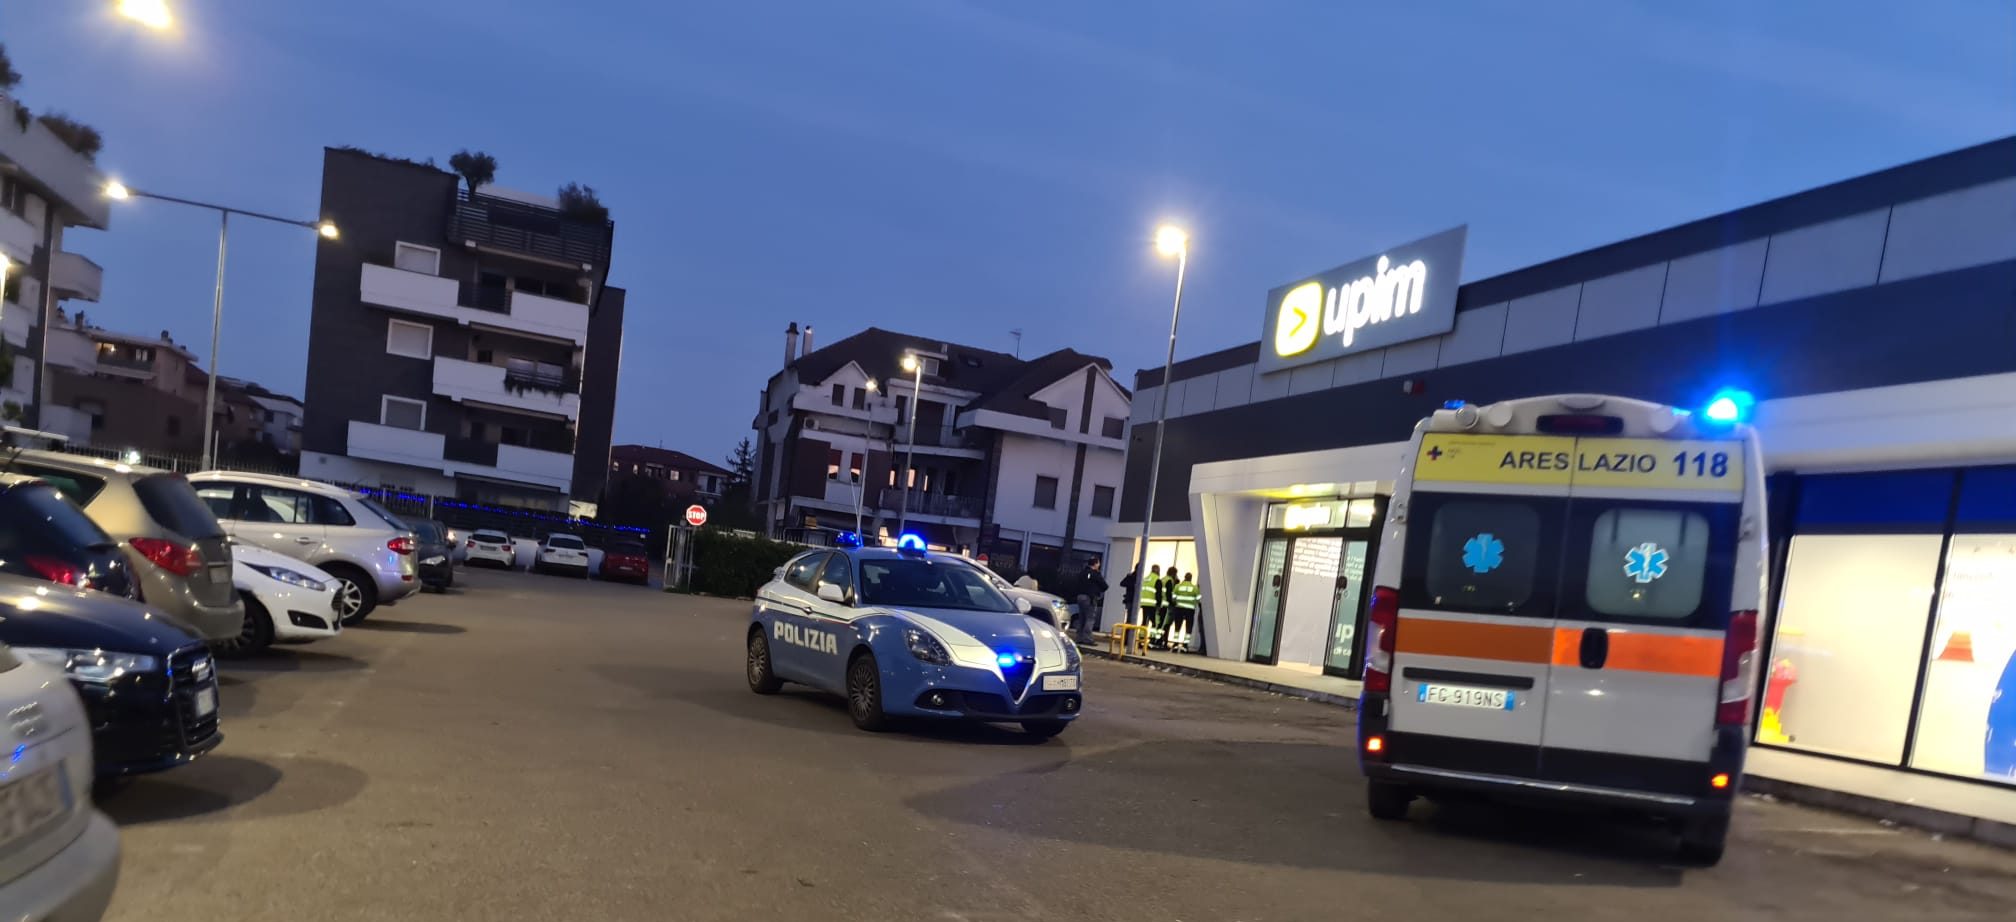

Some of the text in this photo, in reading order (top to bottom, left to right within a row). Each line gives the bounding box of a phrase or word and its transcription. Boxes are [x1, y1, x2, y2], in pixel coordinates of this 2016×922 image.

[1323, 255, 1426, 347] upim
[1499, 450, 1729, 478] ARES LAZIO 118
[688, 511, 705, 520] STOP
[773, 620, 838, 655] POLIZIA
